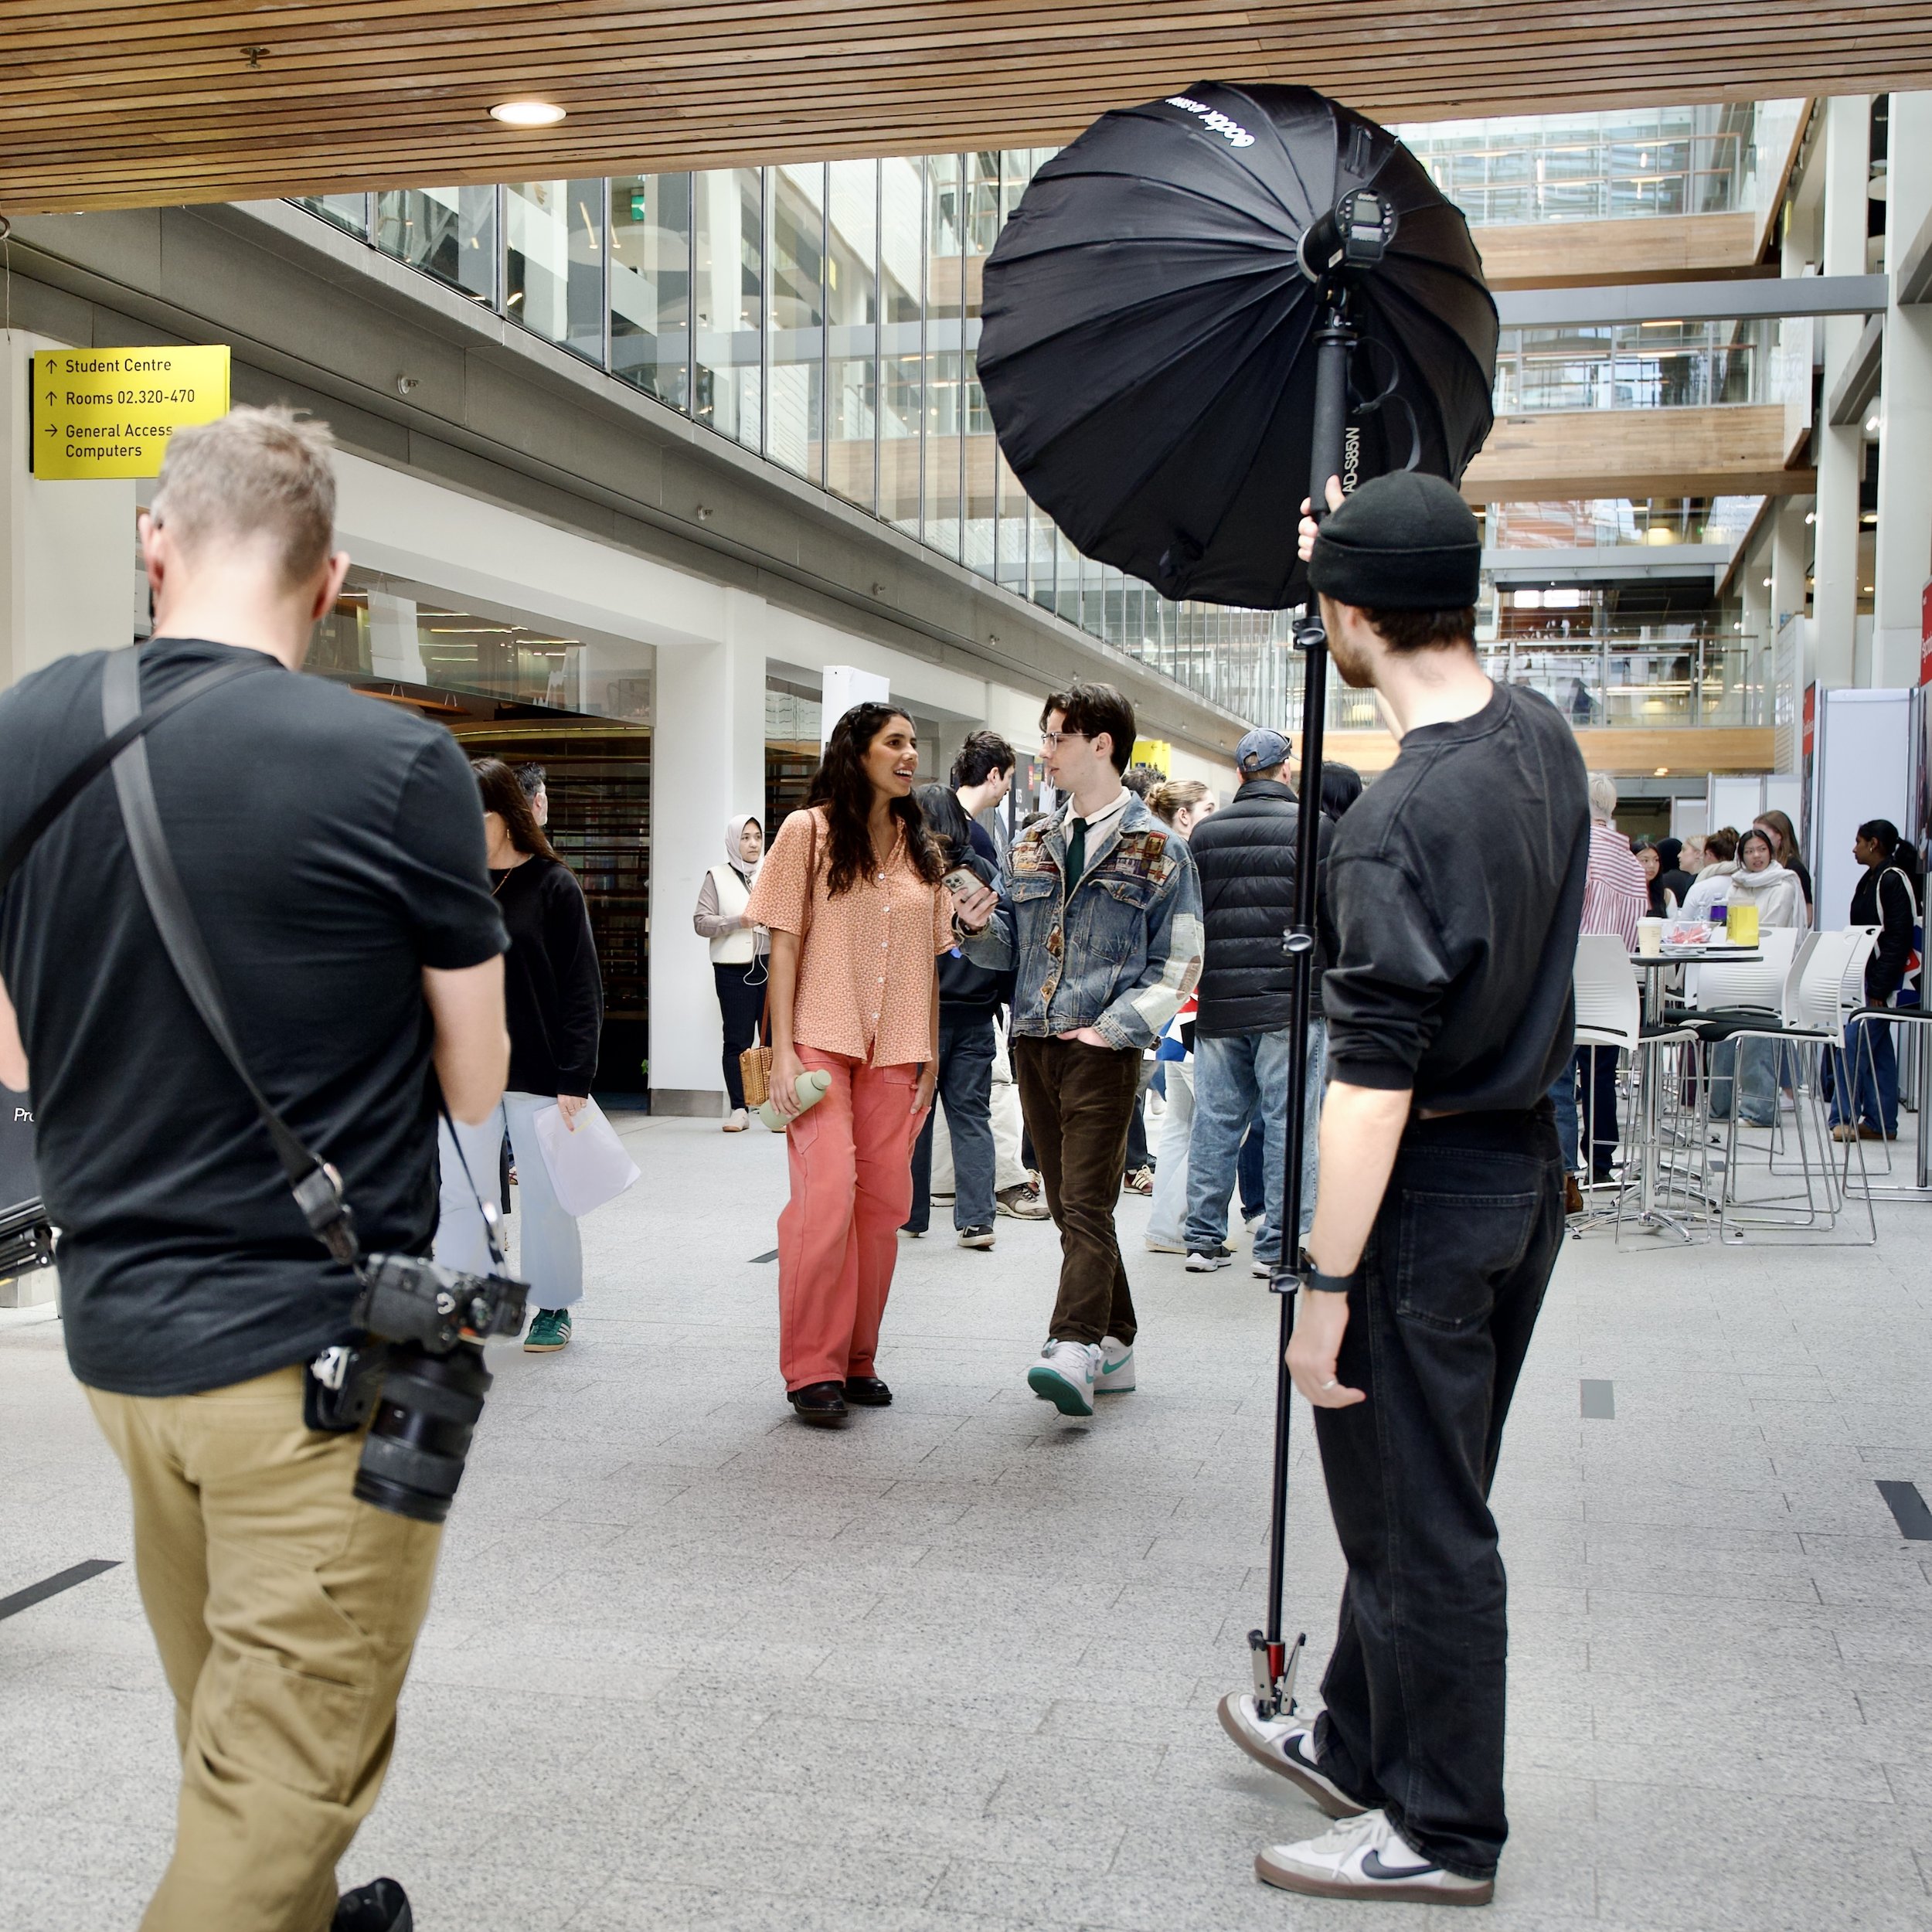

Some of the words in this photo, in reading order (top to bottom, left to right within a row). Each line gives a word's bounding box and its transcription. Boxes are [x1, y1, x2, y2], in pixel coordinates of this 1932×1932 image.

[66, 359, 120, 373] Student
[124, 358, 172, 372] Centre
[66, 392, 114, 405] Rooms
[117, 389, 196, 404] 02.320-470
[66, 423, 121, 438] General
[124, 423, 173, 437] Access
[66, 444, 142, 460] Computers
[1342, 427, 1360, 493] AD-S85W
